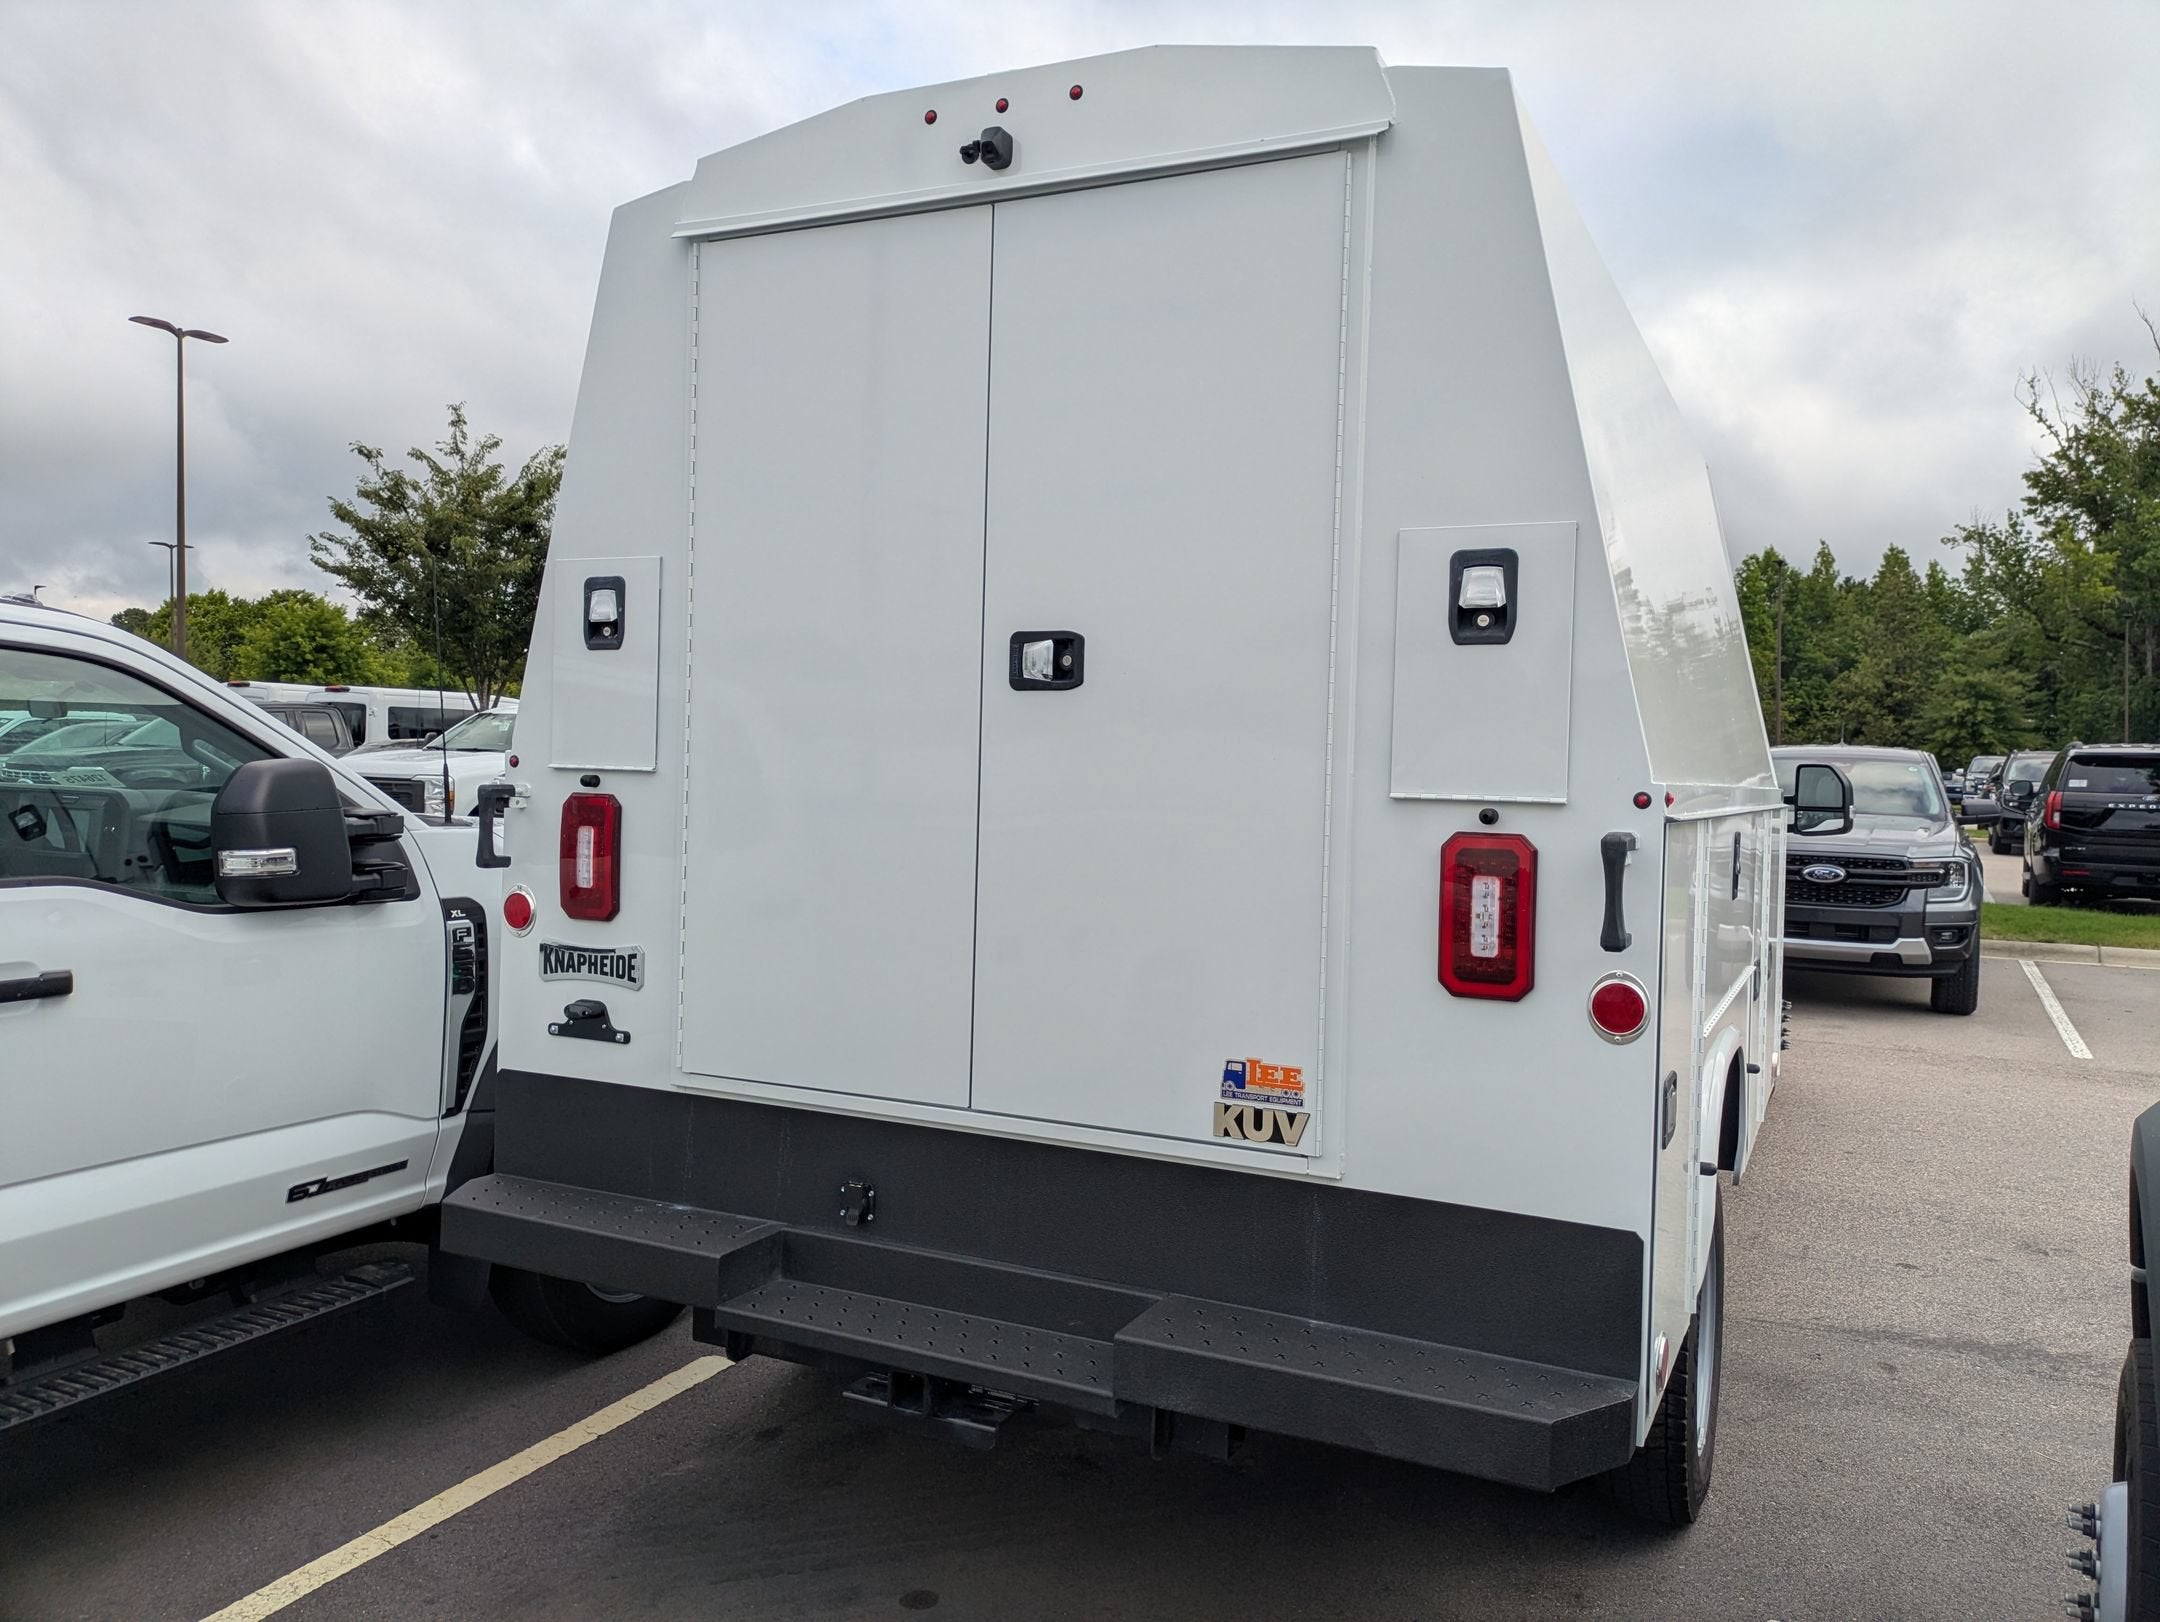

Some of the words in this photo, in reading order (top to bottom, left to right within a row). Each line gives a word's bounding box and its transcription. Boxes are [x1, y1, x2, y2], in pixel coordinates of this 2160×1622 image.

[450, 909, 466, 918] XL
[543, 944, 638, 984] KNAPHEIDE
[1246, 1059, 1305, 1092] LEE
[1234, 1092, 1268, 1102] TRANSPORT
[1269, 1096, 1303, 1106] EQUIPMENT
[1213, 1101, 1311, 1147] KUV
